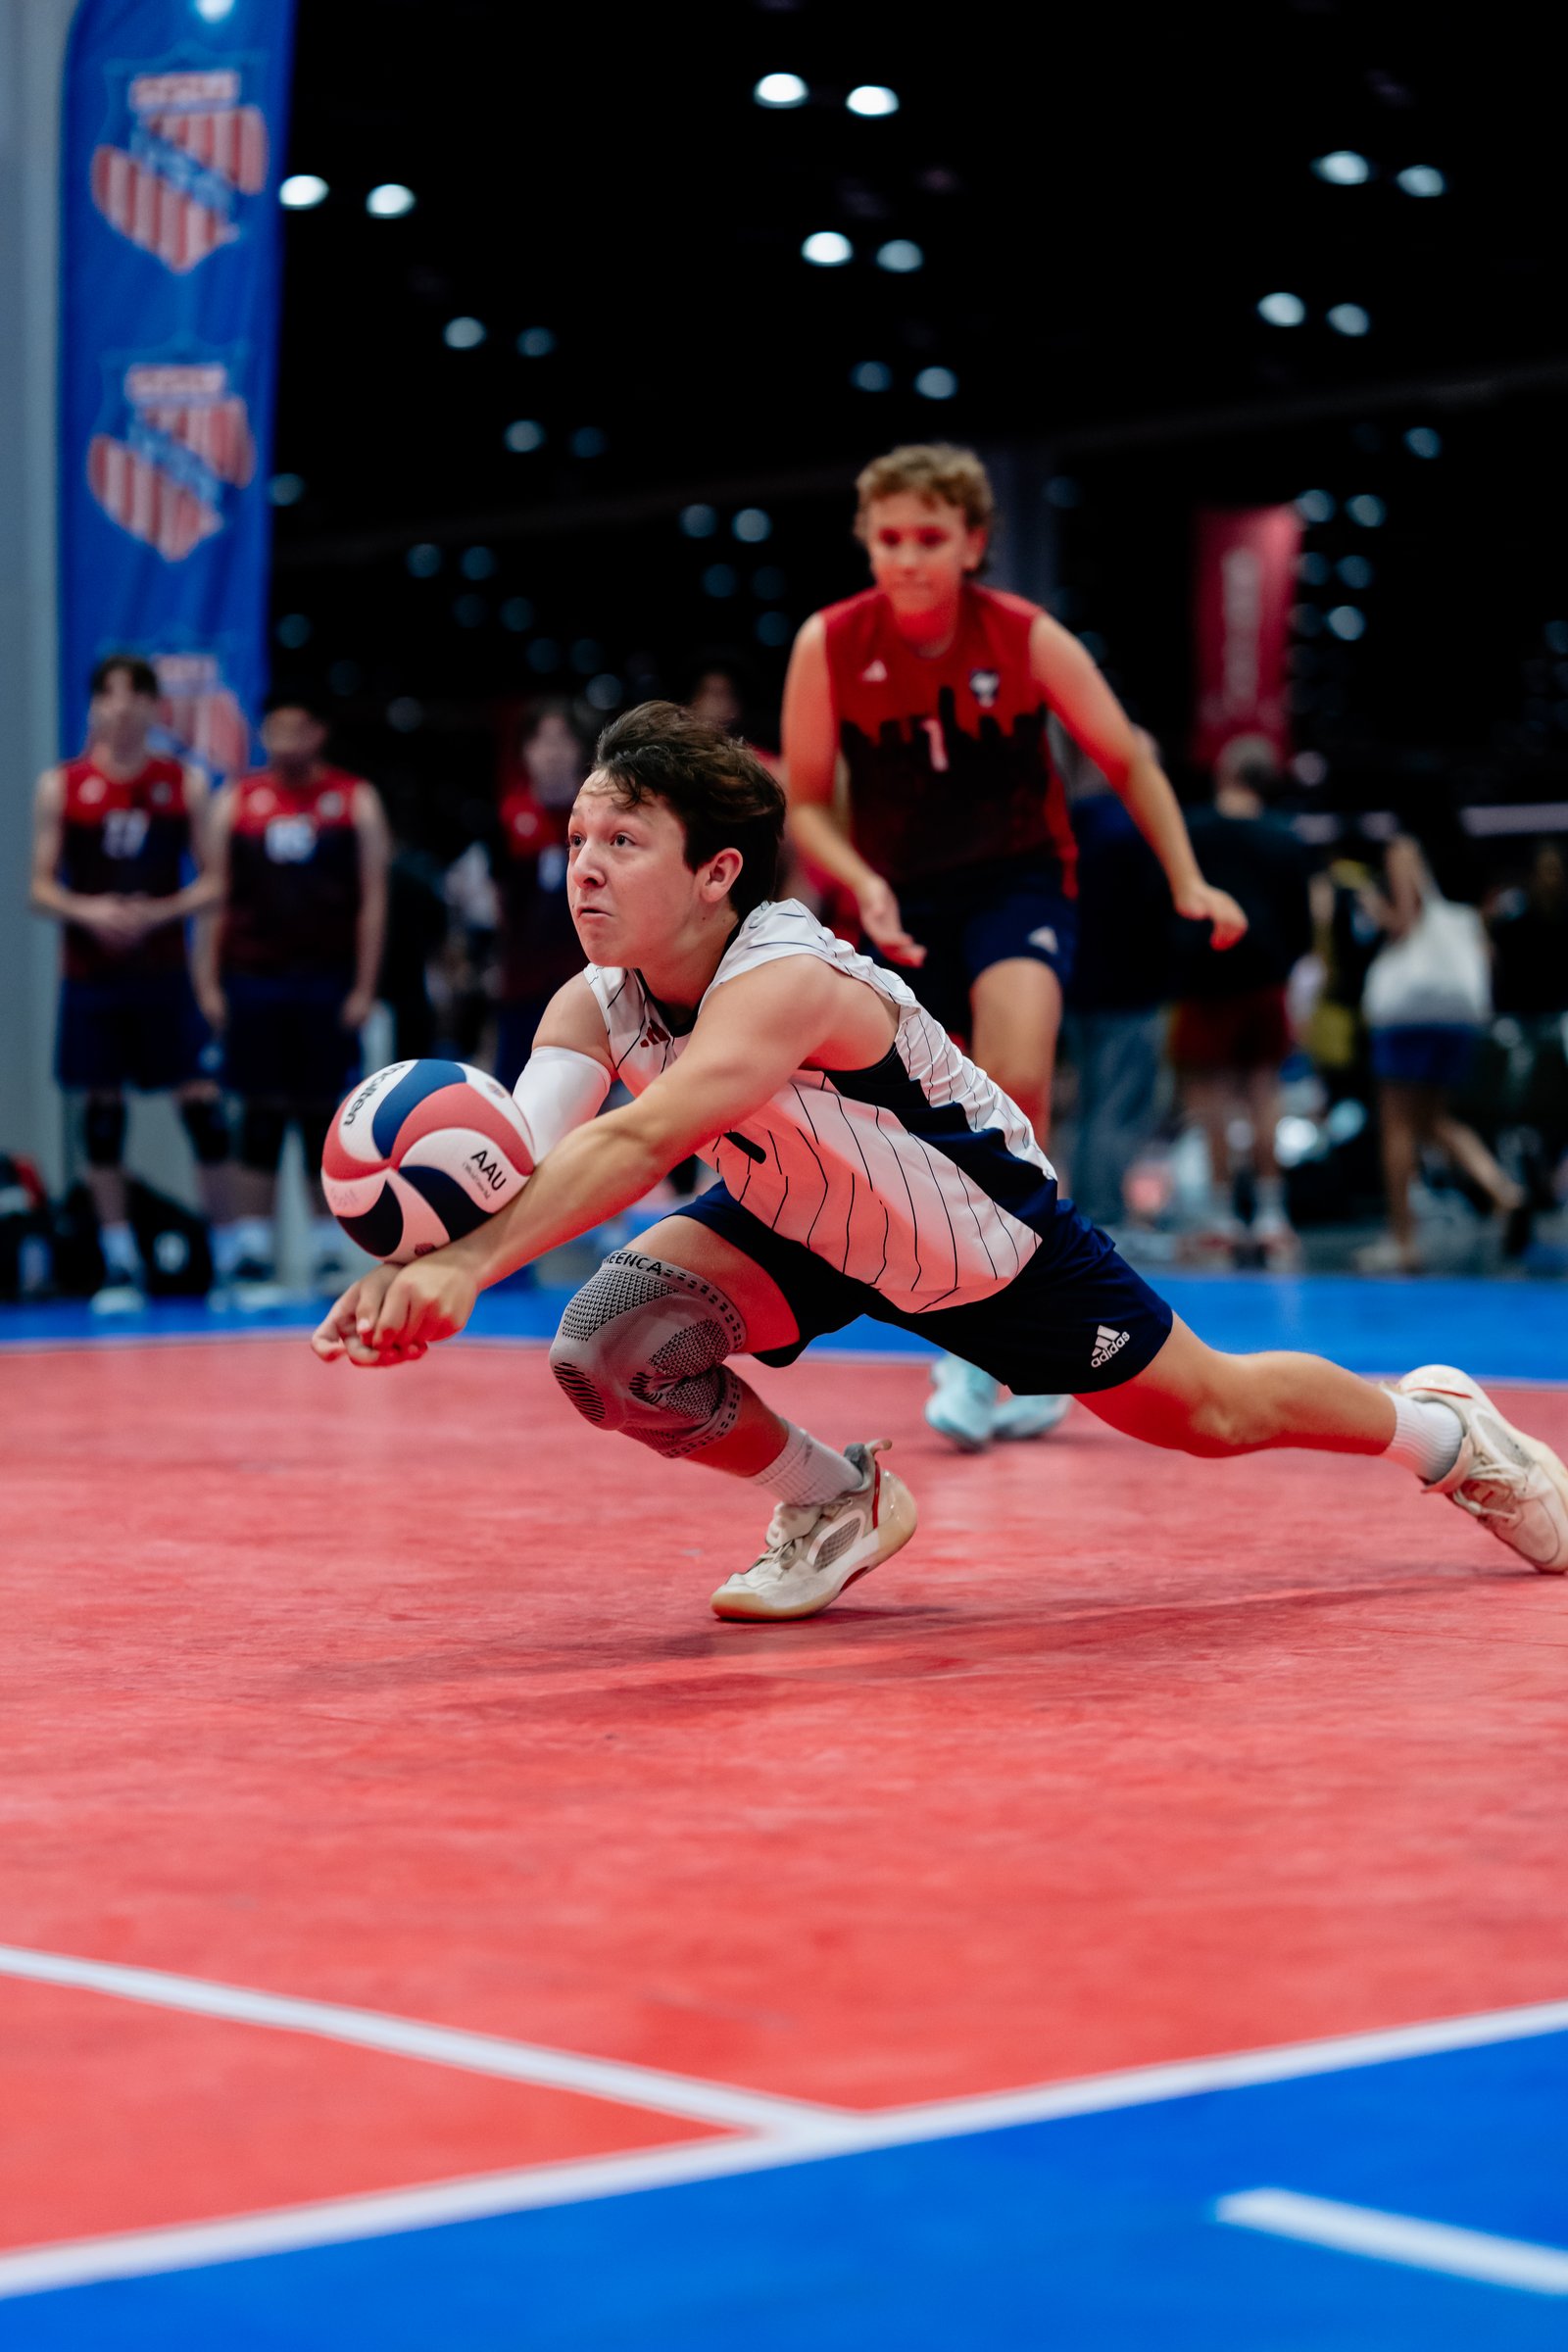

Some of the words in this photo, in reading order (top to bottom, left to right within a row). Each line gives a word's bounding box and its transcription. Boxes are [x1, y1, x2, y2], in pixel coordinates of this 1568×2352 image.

[470, 1151, 507, 1191] AAU
[607, 1251, 662, 1276] EENCA
[1091, 1331, 1130, 1368] adidas
